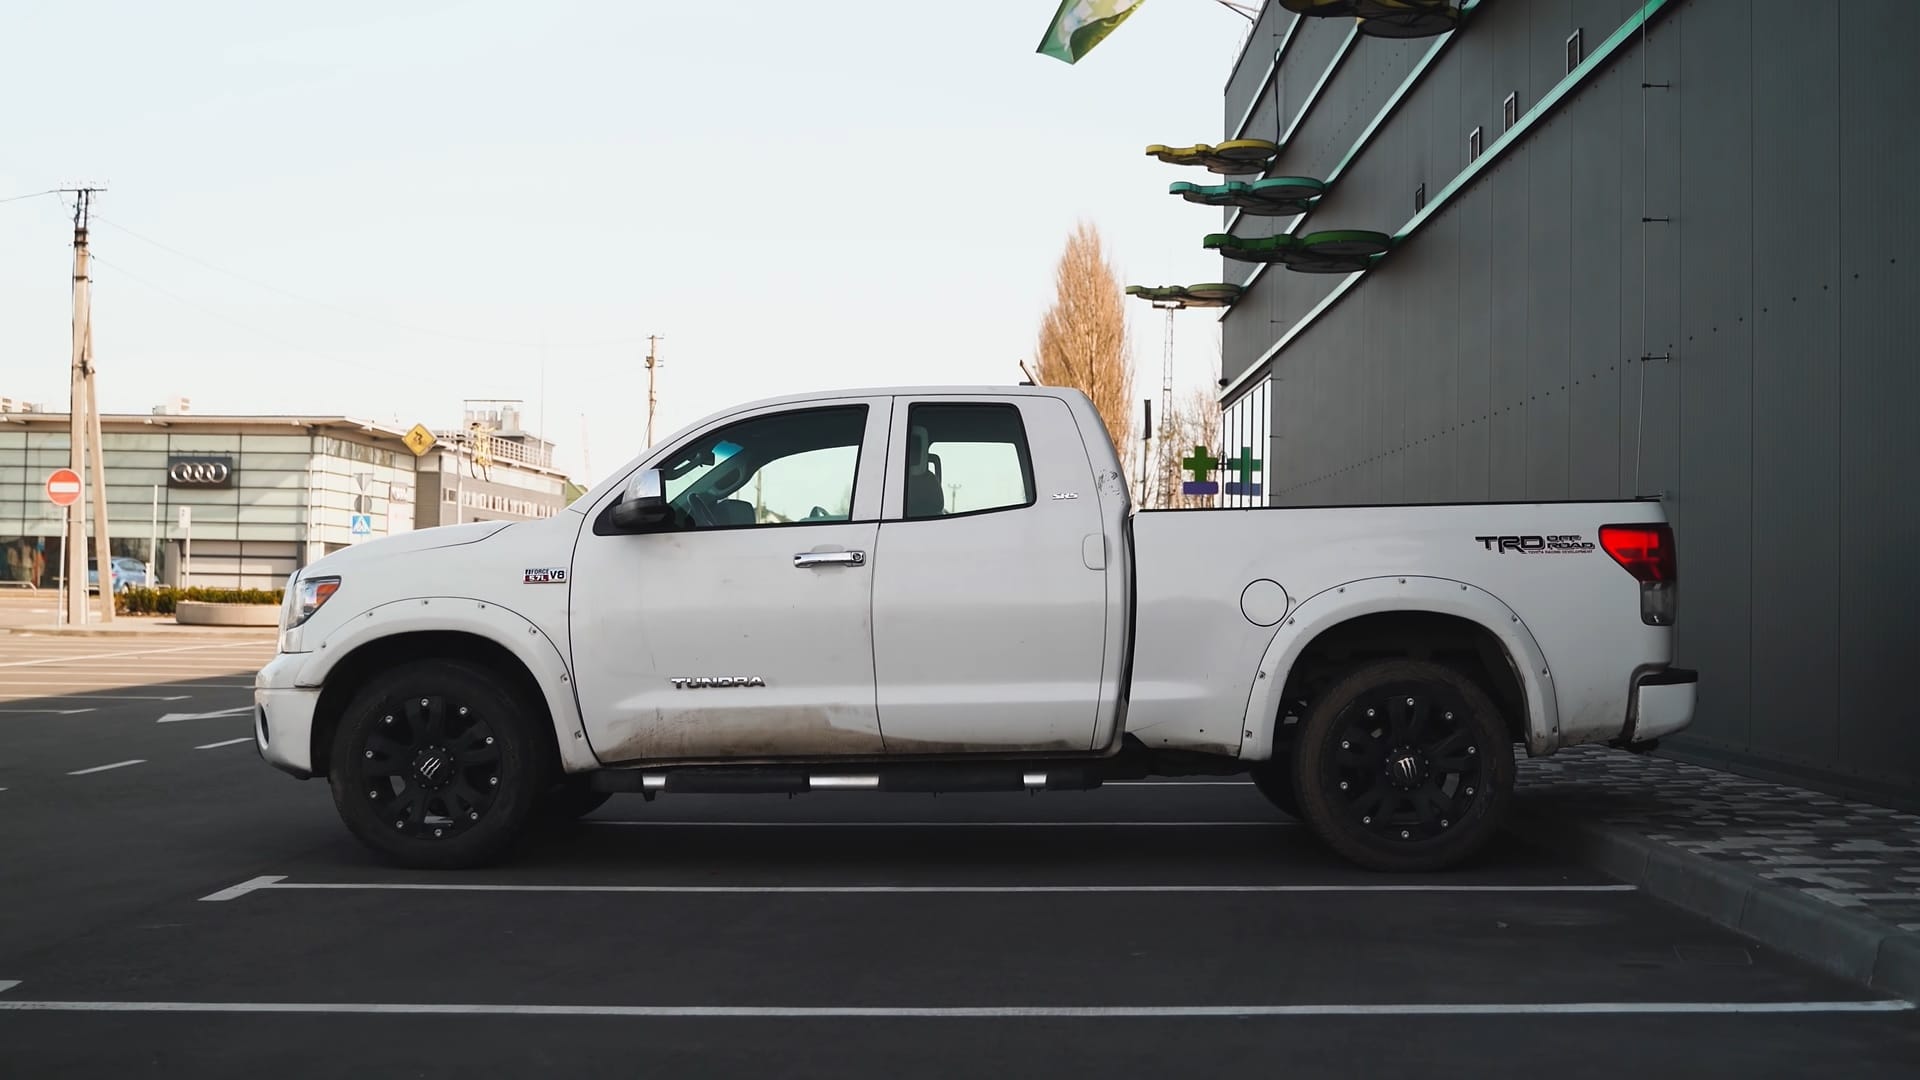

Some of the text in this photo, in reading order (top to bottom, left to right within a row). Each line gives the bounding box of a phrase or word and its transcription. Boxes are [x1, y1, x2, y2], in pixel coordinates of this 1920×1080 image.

[1475, 535, 1545, 554] TRD
[1547, 542, 1595, 550] ROAD
[550, 570, 565, 580] V8
[671, 676, 766, 690] TUNDRA
